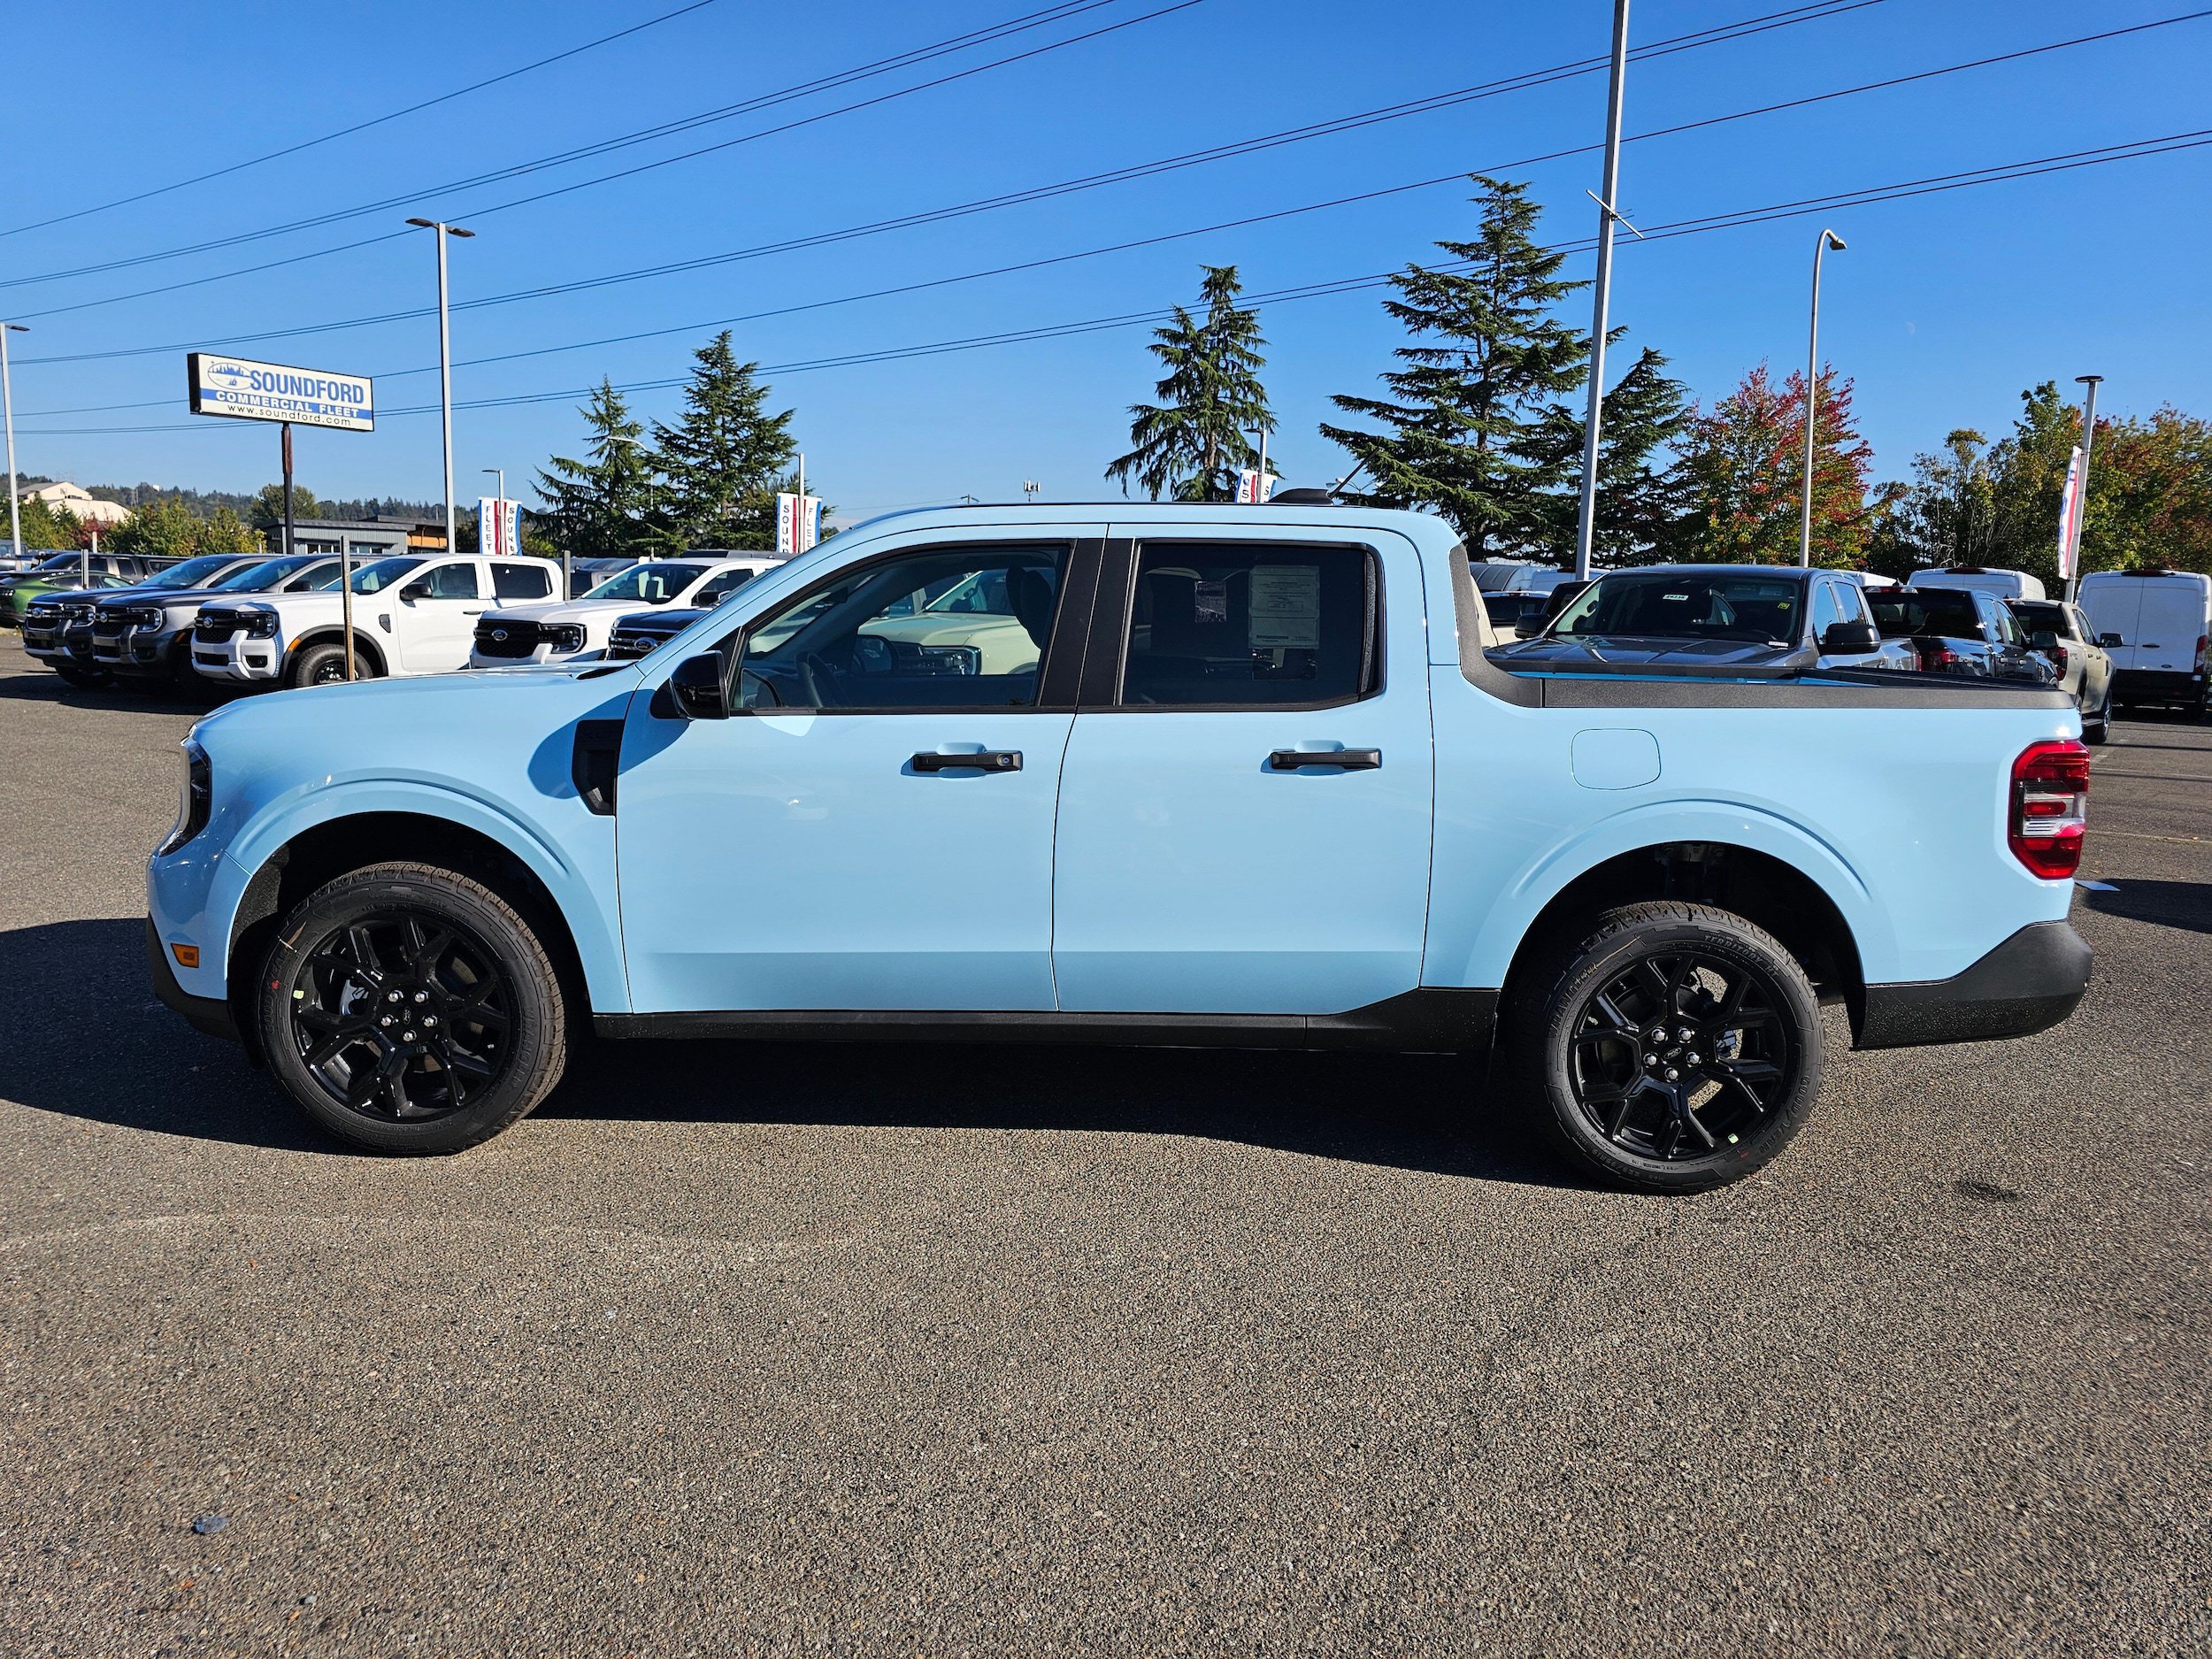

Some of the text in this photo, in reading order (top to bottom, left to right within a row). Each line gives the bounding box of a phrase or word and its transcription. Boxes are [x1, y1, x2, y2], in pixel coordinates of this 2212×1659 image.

[250, 370, 365, 404] SOUNDFORD
[216, 391, 359, 418] COMMERCIAL FLEET
[227, 404, 351, 426] www.soundford.com
[1703, 934, 1763, 964] TERRITORY
